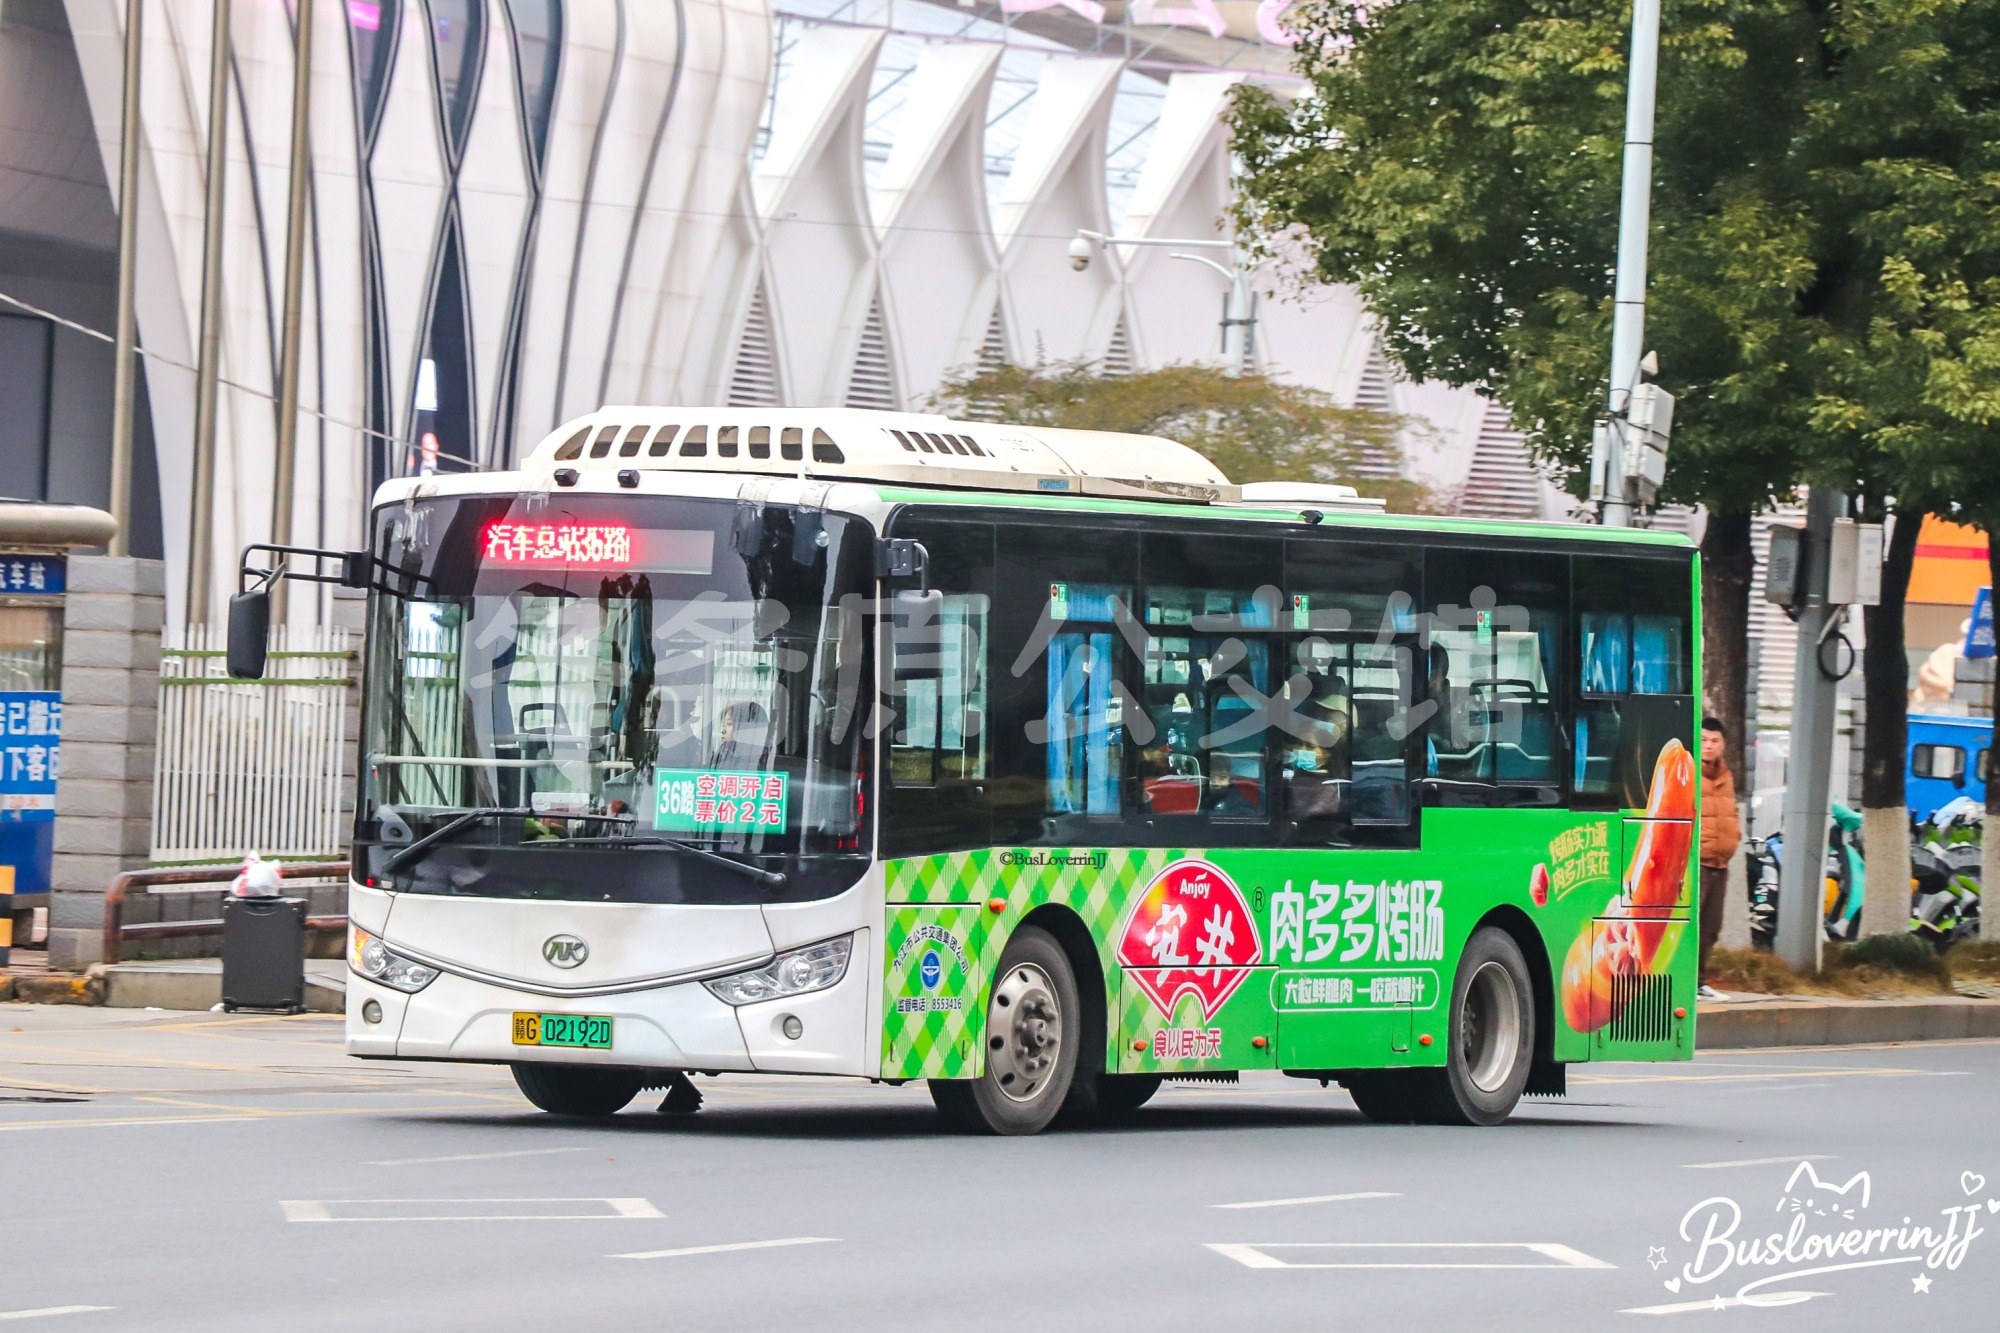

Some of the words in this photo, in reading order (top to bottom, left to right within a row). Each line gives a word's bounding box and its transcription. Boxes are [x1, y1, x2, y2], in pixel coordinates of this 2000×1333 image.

[660, 780, 695, 815] 36路
[697, 775, 783, 805] 空调开启
[695, 799, 780, 830] 票价2元
[1179, 873, 1211, 899] Anjoy
[1552, 848, 1610, 894] 肉多才实在
[1269, 879, 1444, 963] 肉多多烤肠
[893, 924, 969, 974] 九江市公共交通集团公司
[1145, 902, 1235, 989] 安井
[1284, 977, 1353, 1004] 大粒鲜腿肉
[1153, 1028, 1221, 1058] 食以民为天
